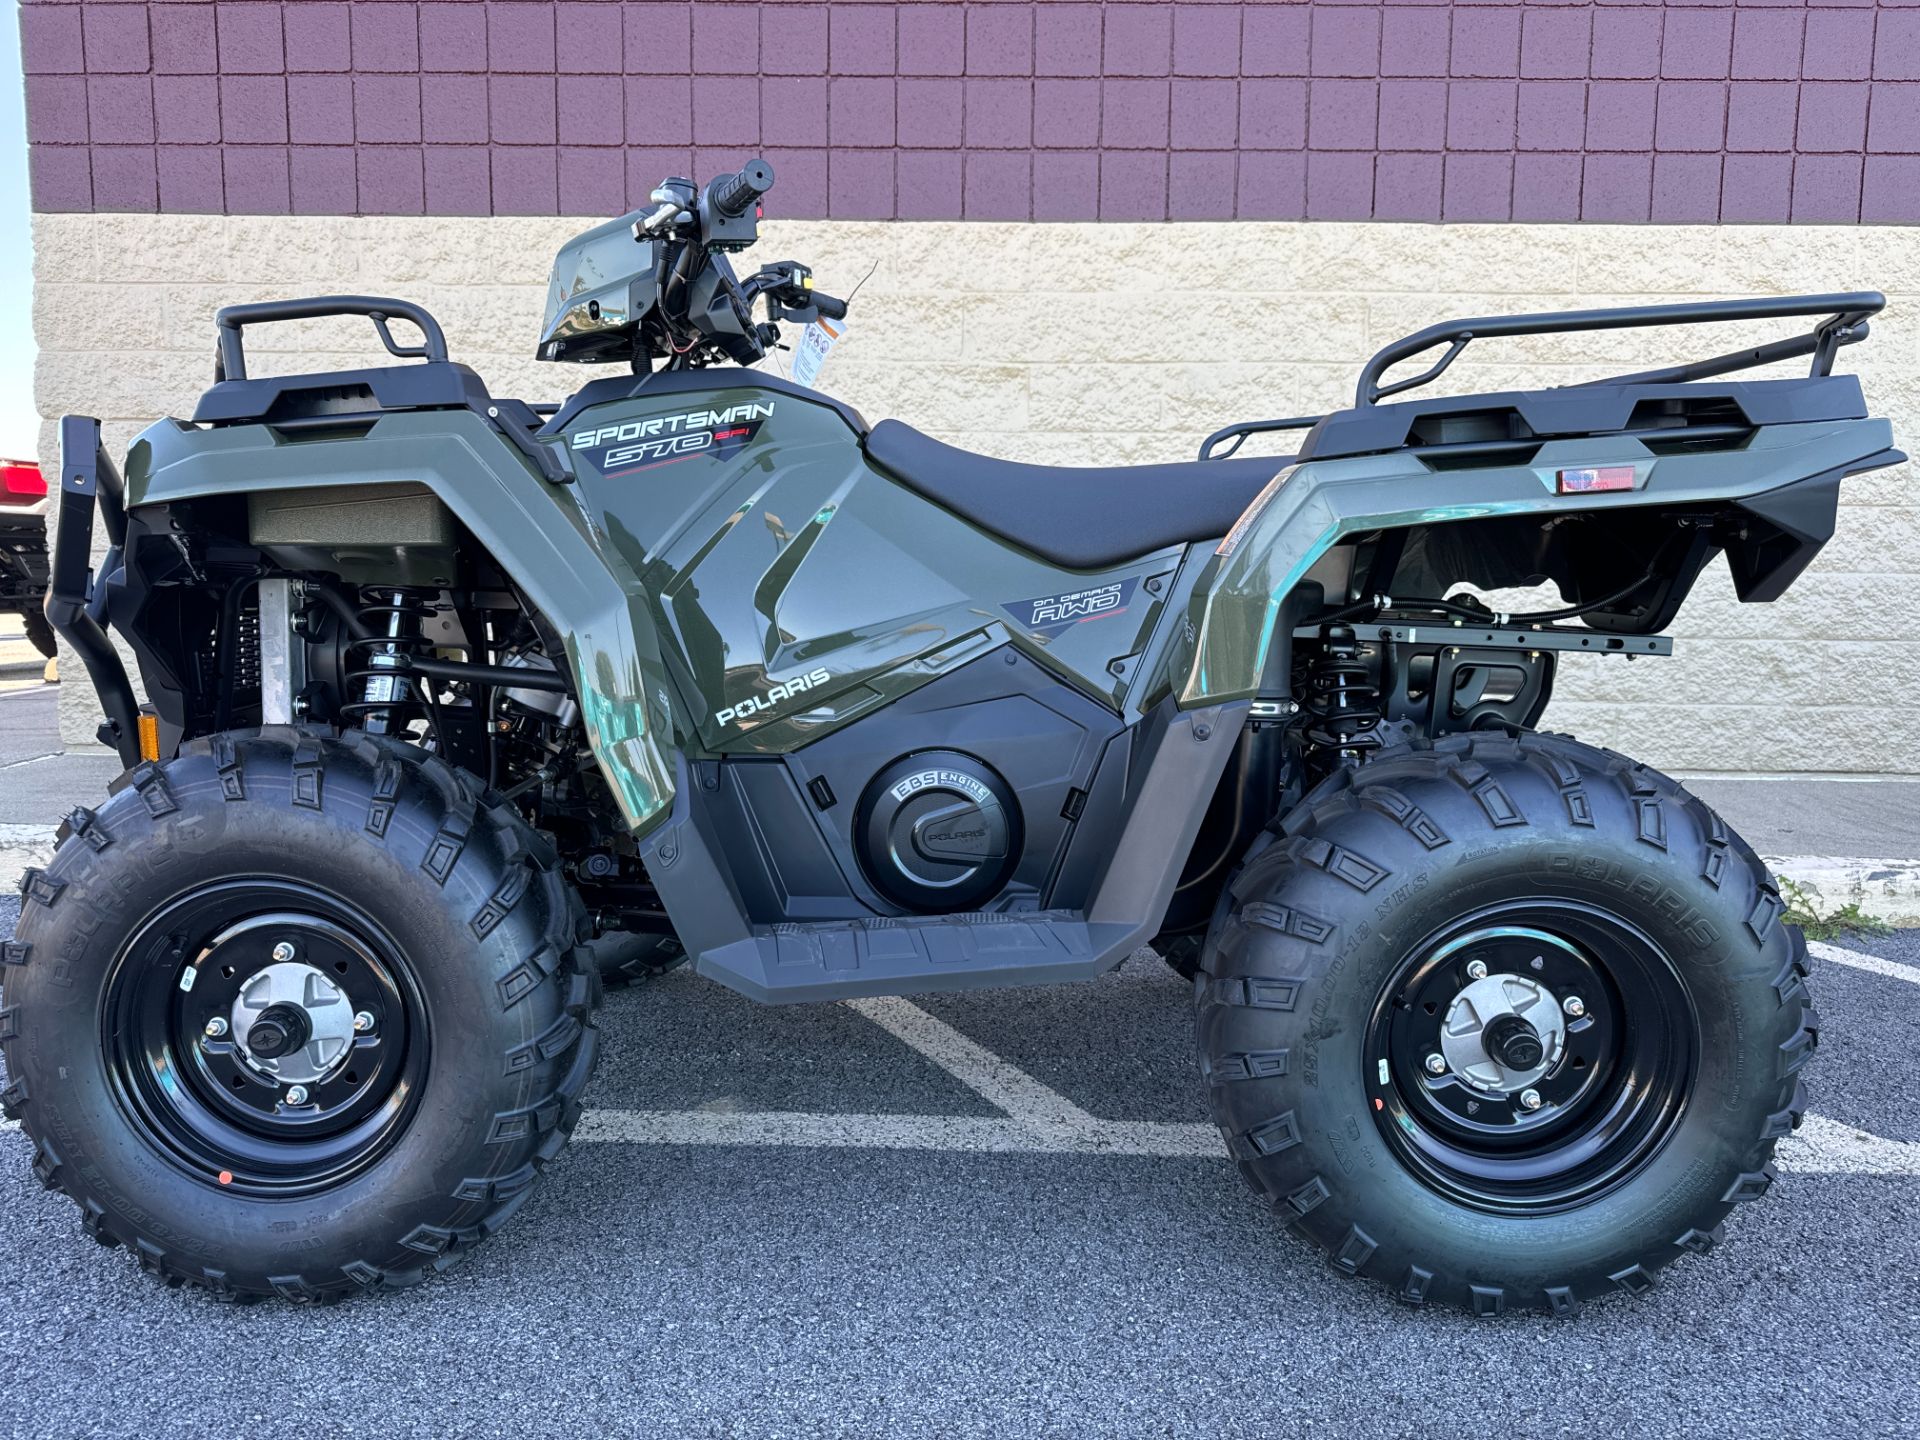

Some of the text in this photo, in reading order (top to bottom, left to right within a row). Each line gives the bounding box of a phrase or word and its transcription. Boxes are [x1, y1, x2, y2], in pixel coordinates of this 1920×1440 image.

[571, 401, 776, 450] SPORTSMAN
[604, 428, 749, 468] 570 EFI
[1031, 591, 1121, 624] AWD
[1033, 583, 1122, 607] ON DEMAND
[715, 666, 831, 727] POLARIS
[897, 773, 936, 797] EBS
[940, 772, 986, 796] ENGINE
[928, 829, 985, 841] POLARIS
[1374, 872, 1430, 921] NHS
[1546, 850, 1721, 950] POLARIS
